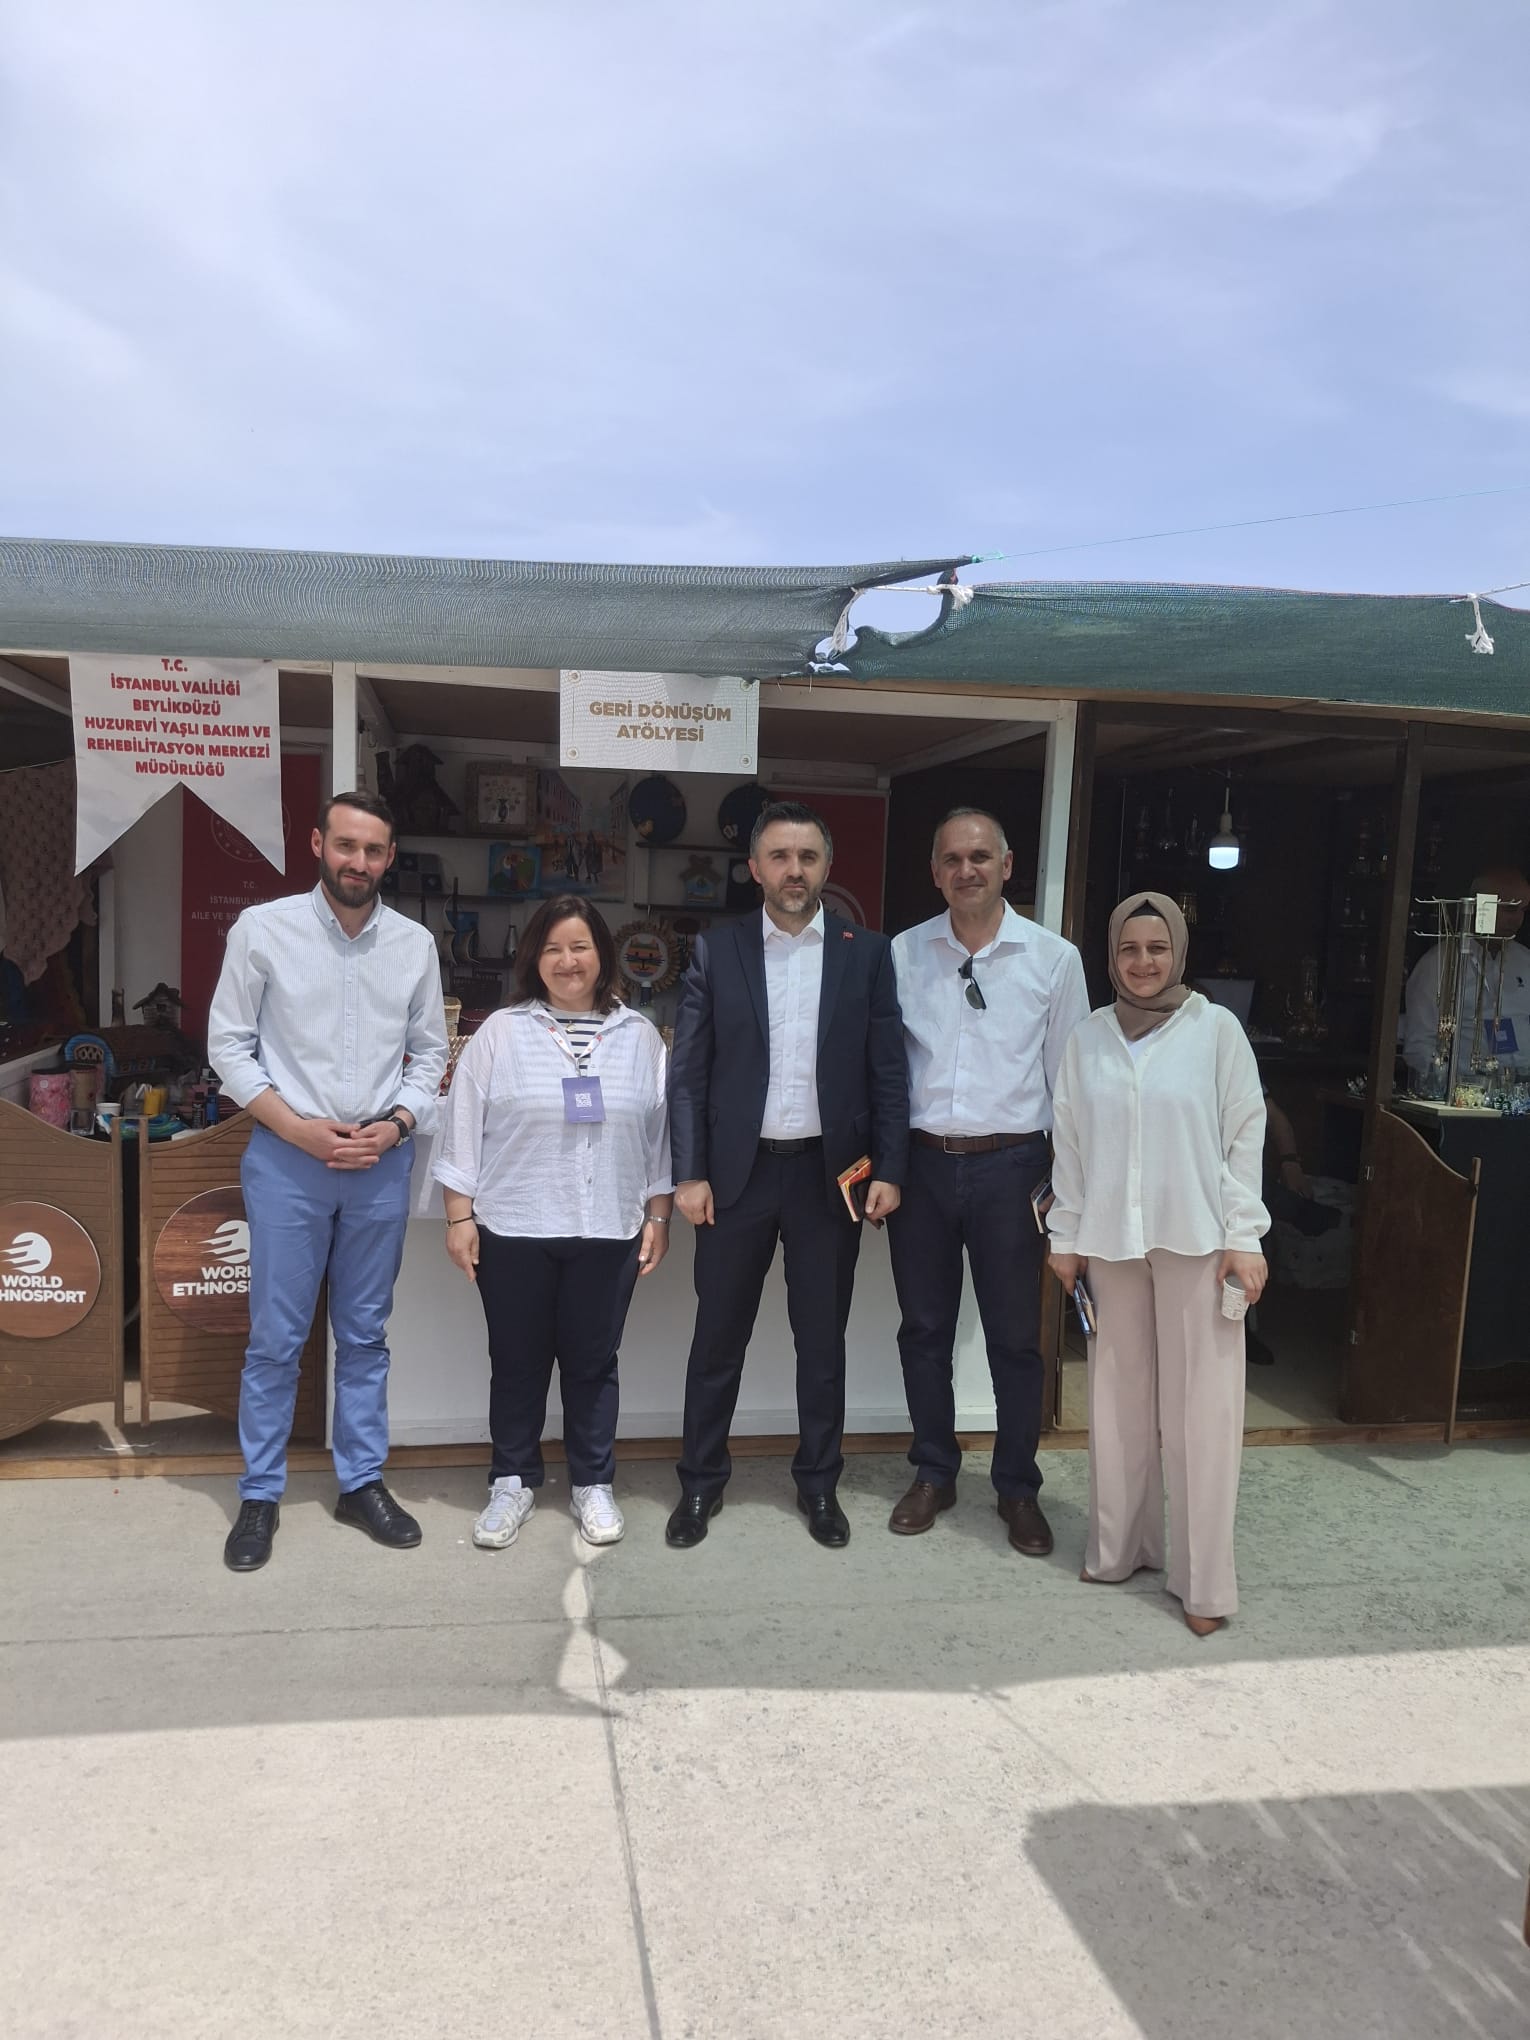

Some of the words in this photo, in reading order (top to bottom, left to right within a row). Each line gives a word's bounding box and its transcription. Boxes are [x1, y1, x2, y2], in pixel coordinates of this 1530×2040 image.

[161, 658, 188, 672] T.C.
[110, 673, 179, 692] İSTANBUL
[181, 679, 241, 696] VALİLİĞİ
[132, 697, 221, 716] BEYLİKDÜZÜ
[589, 700, 632, 717] GERİ
[638, 701, 732, 723] DÖNÜŞÜM
[84, 717, 157, 732] HUZUREVİ
[160, 720, 199, 738] YAŞLI
[202, 724, 250, 738] BAKIM
[252, 726, 271, 738] VE
[616, 722, 704, 742] ATÖLYESİ
[87, 737, 205, 756] REHEBİLİTASYON
[208, 743, 270, 759] MERKEZİ
[135, 759, 225, 777] MÜDÜRLÜĞÜ
[1, 1274, 63, 1288] WORLD
[201, 1265, 251, 1280] WOR
[0, 1289, 86, 1304] HNOSPORT
[173, 1280, 251, 1297] ETHNOS
